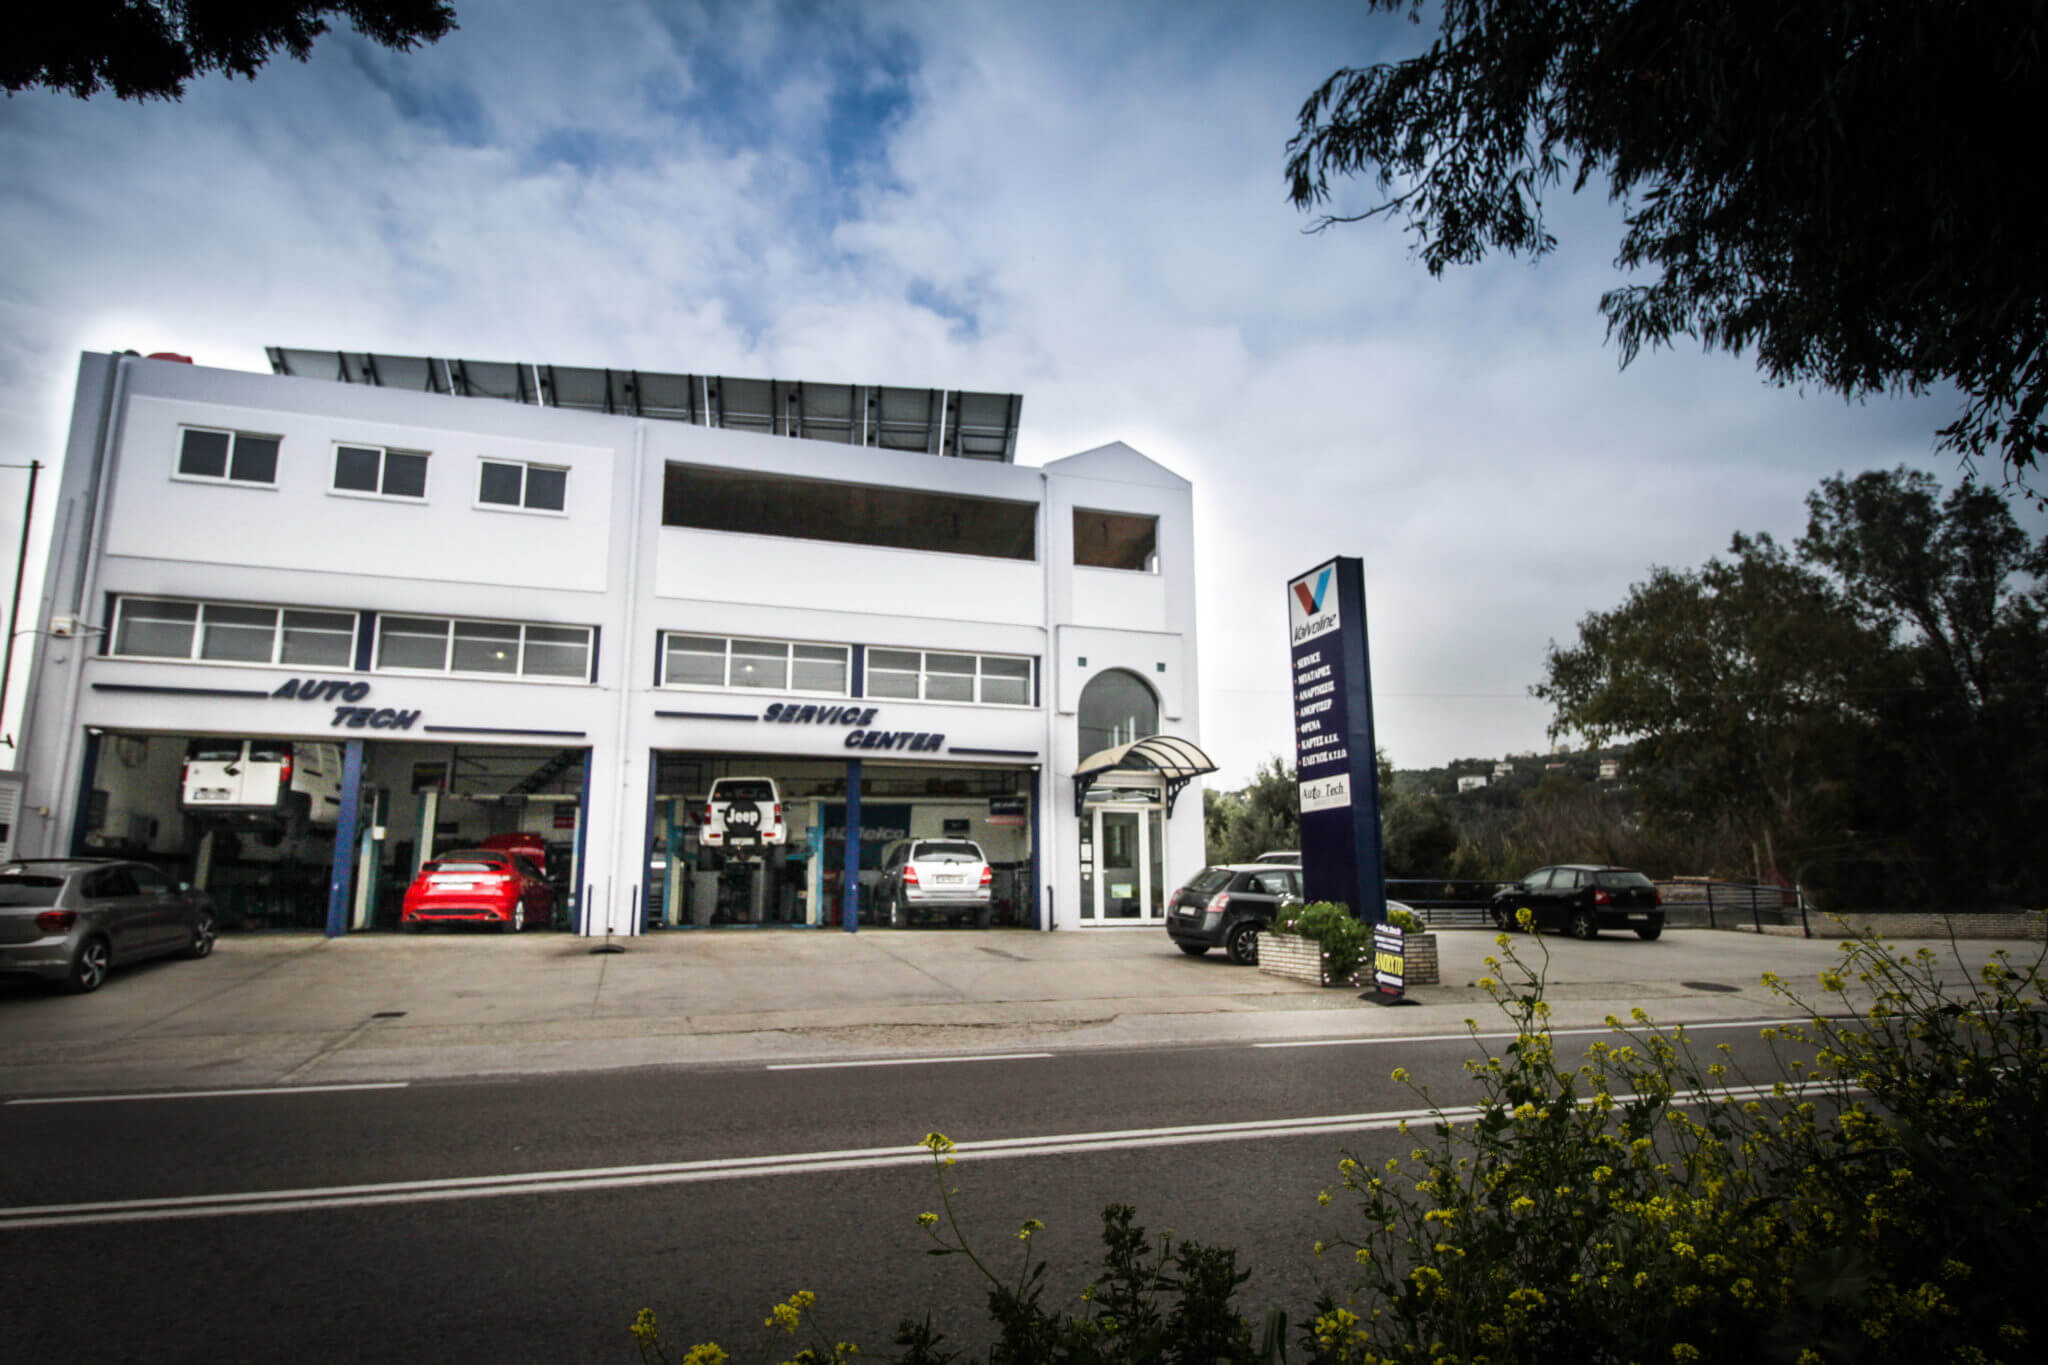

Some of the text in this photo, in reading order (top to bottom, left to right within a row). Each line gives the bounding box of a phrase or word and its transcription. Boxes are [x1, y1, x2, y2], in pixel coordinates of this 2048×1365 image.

[1294, 613, 1337, 642] Valvoline
[1297, 651, 1321, 669] SERVICE
[1298, 664, 1332, 685] ΜΠΑΤΑΡΙΕΣ
[271, 678, 370, 702] AUTO
[331, 706, 421, 730] TECH
[763, 703, 879, 727] SERVICE
[1300, 720, 1321, 734] ΦΡΕΝΑ
[844, 729, 945, 752] CENTER
[1301, 735, 1324, 750] ΚΑΡΤΕΣ
[1304, 781, 1344, 799] Auto Tech
[726, 808, 759, 826] Jeep
